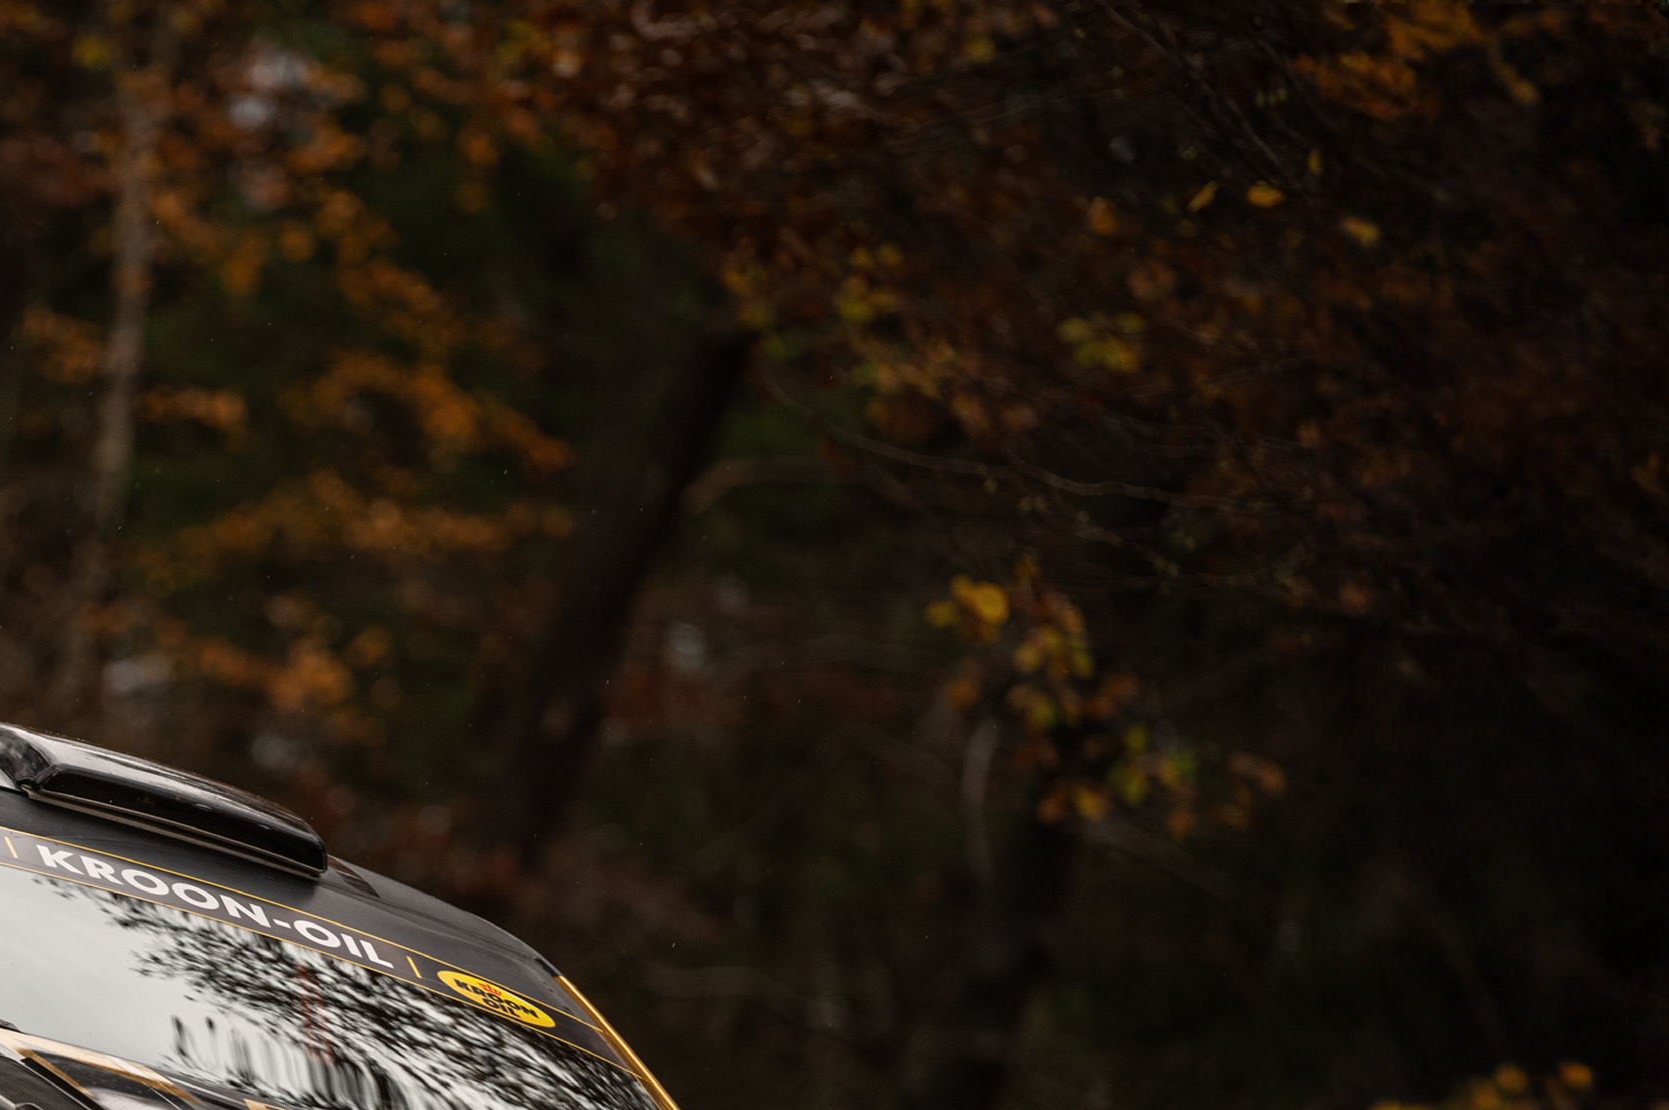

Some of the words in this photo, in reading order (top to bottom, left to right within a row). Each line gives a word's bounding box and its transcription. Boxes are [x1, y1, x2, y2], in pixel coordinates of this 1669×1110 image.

[36, 844, 394, 969] KROON-OIL
[453, 978, 540, 1019] KROON
[483, 998, 522, 1018] OIL
